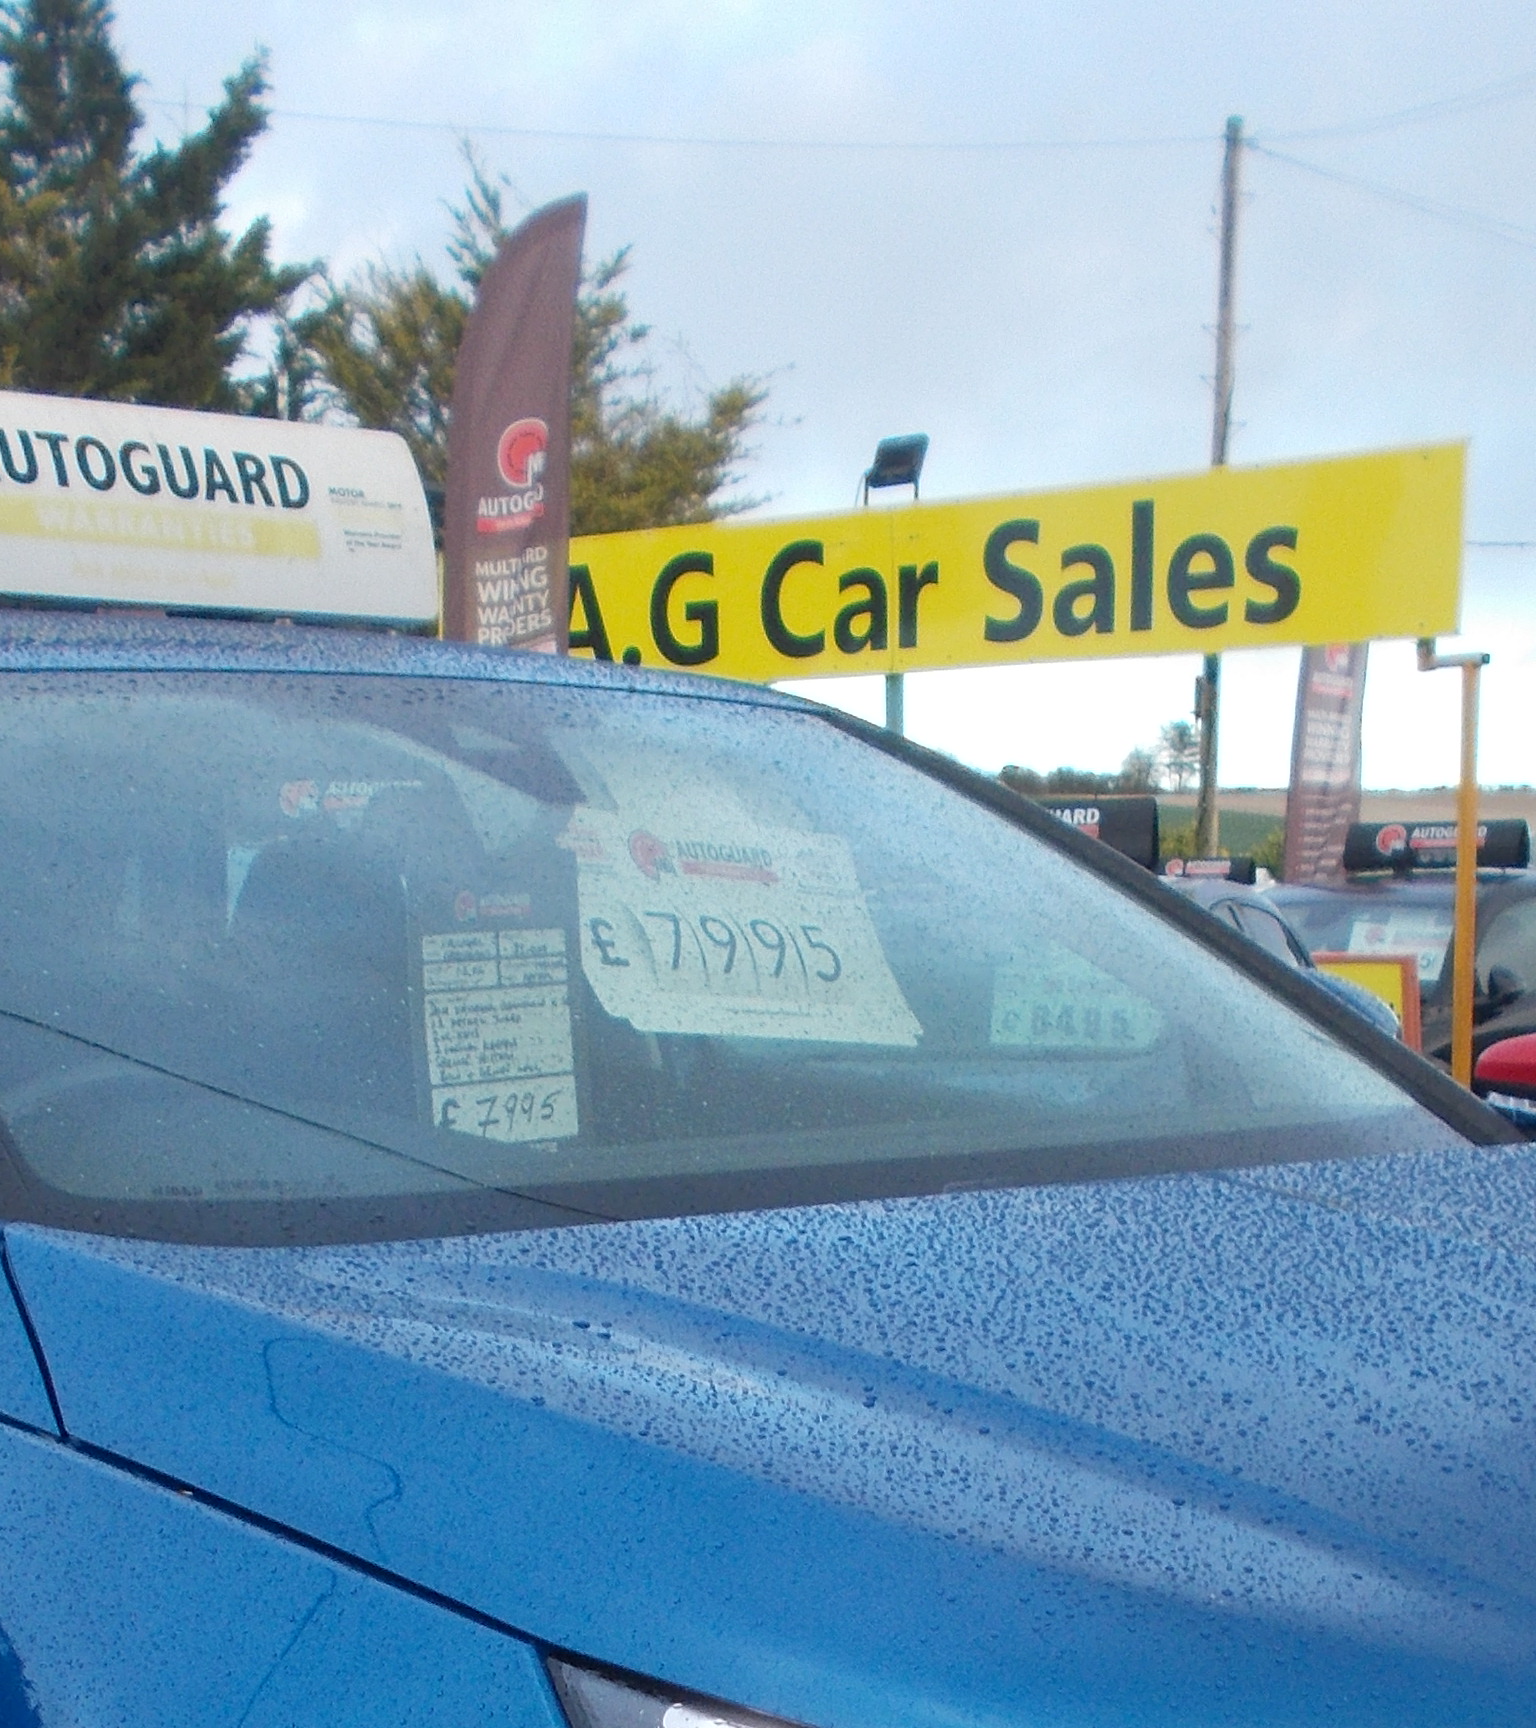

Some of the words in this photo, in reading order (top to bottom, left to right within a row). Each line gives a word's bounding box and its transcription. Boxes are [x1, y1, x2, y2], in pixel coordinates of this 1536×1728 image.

[760, 540, 939, 660] Car
[983, 499, 1301, 645] Sales
[589, 912, 842, 982] £7995
